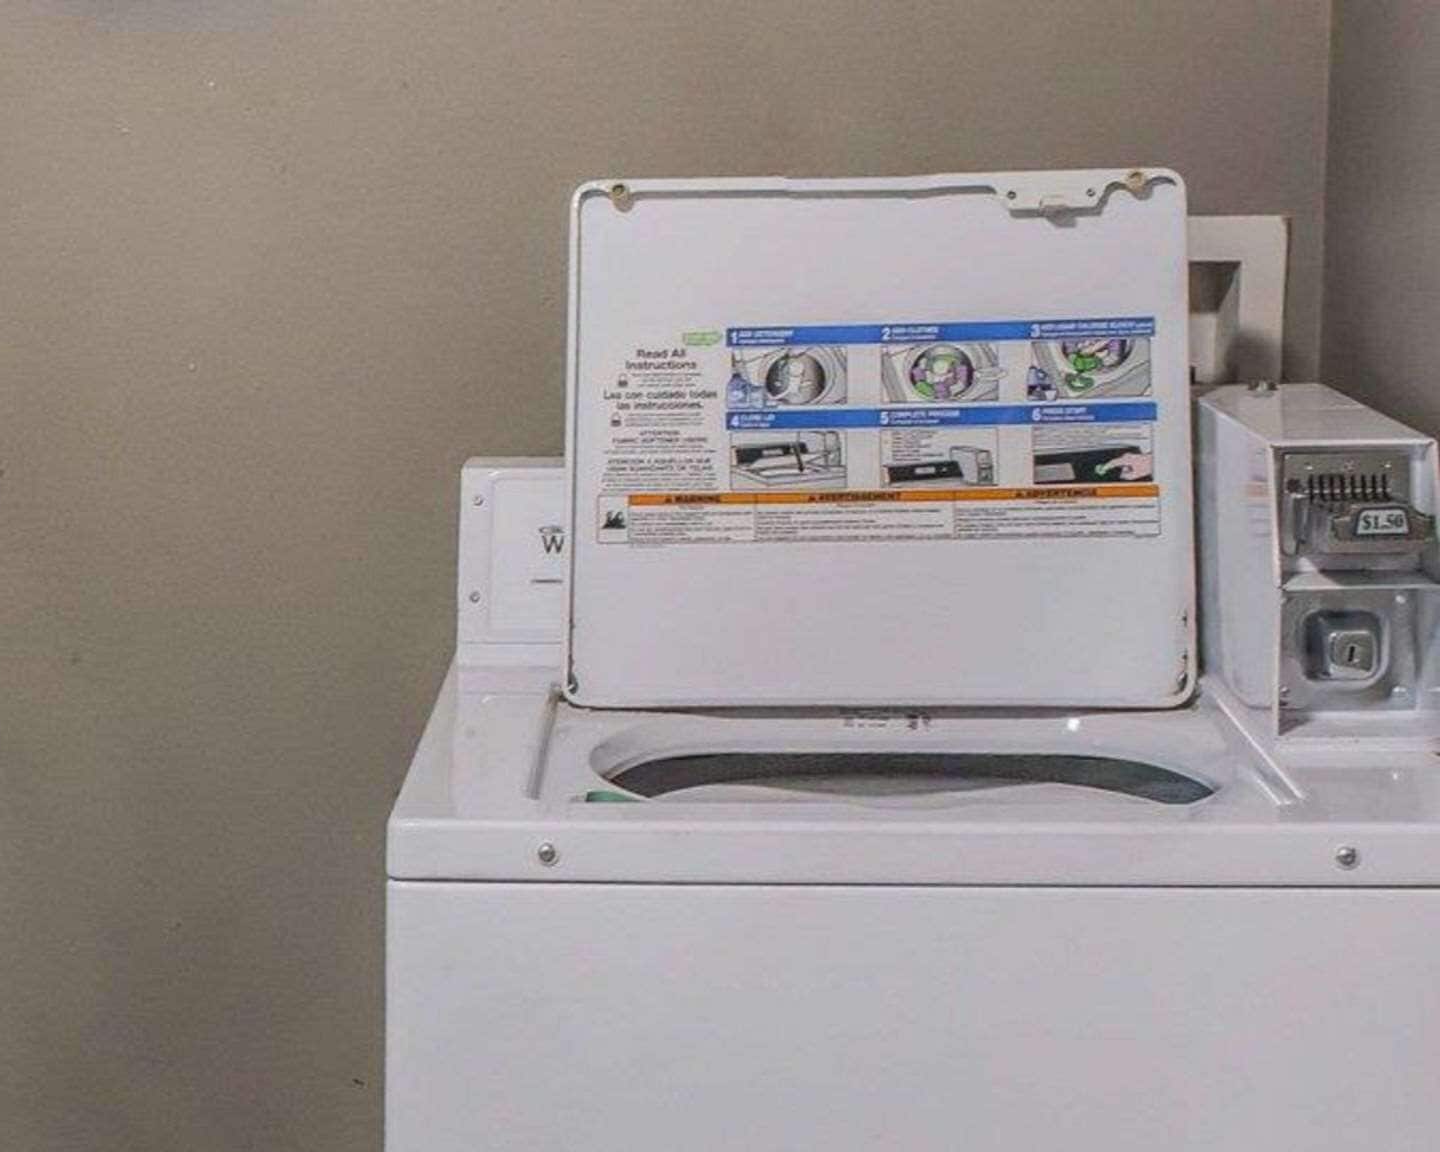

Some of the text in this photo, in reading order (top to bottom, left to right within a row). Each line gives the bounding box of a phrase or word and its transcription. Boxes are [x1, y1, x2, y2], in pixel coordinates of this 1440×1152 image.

[881, 327, 890, 341] 2
[1030, 323, 1040, 338] 3
[636, 348, 686, 359] Read All
[625, 360, 697, 370] Instructions
[625, 391, 643, 400] con
[730, 414, 739, 427] 4
[880, 411, 889, 425] 5
[1032, 407, 1041, 421] 6
[1361, 513, 1404, 531] $1.50
